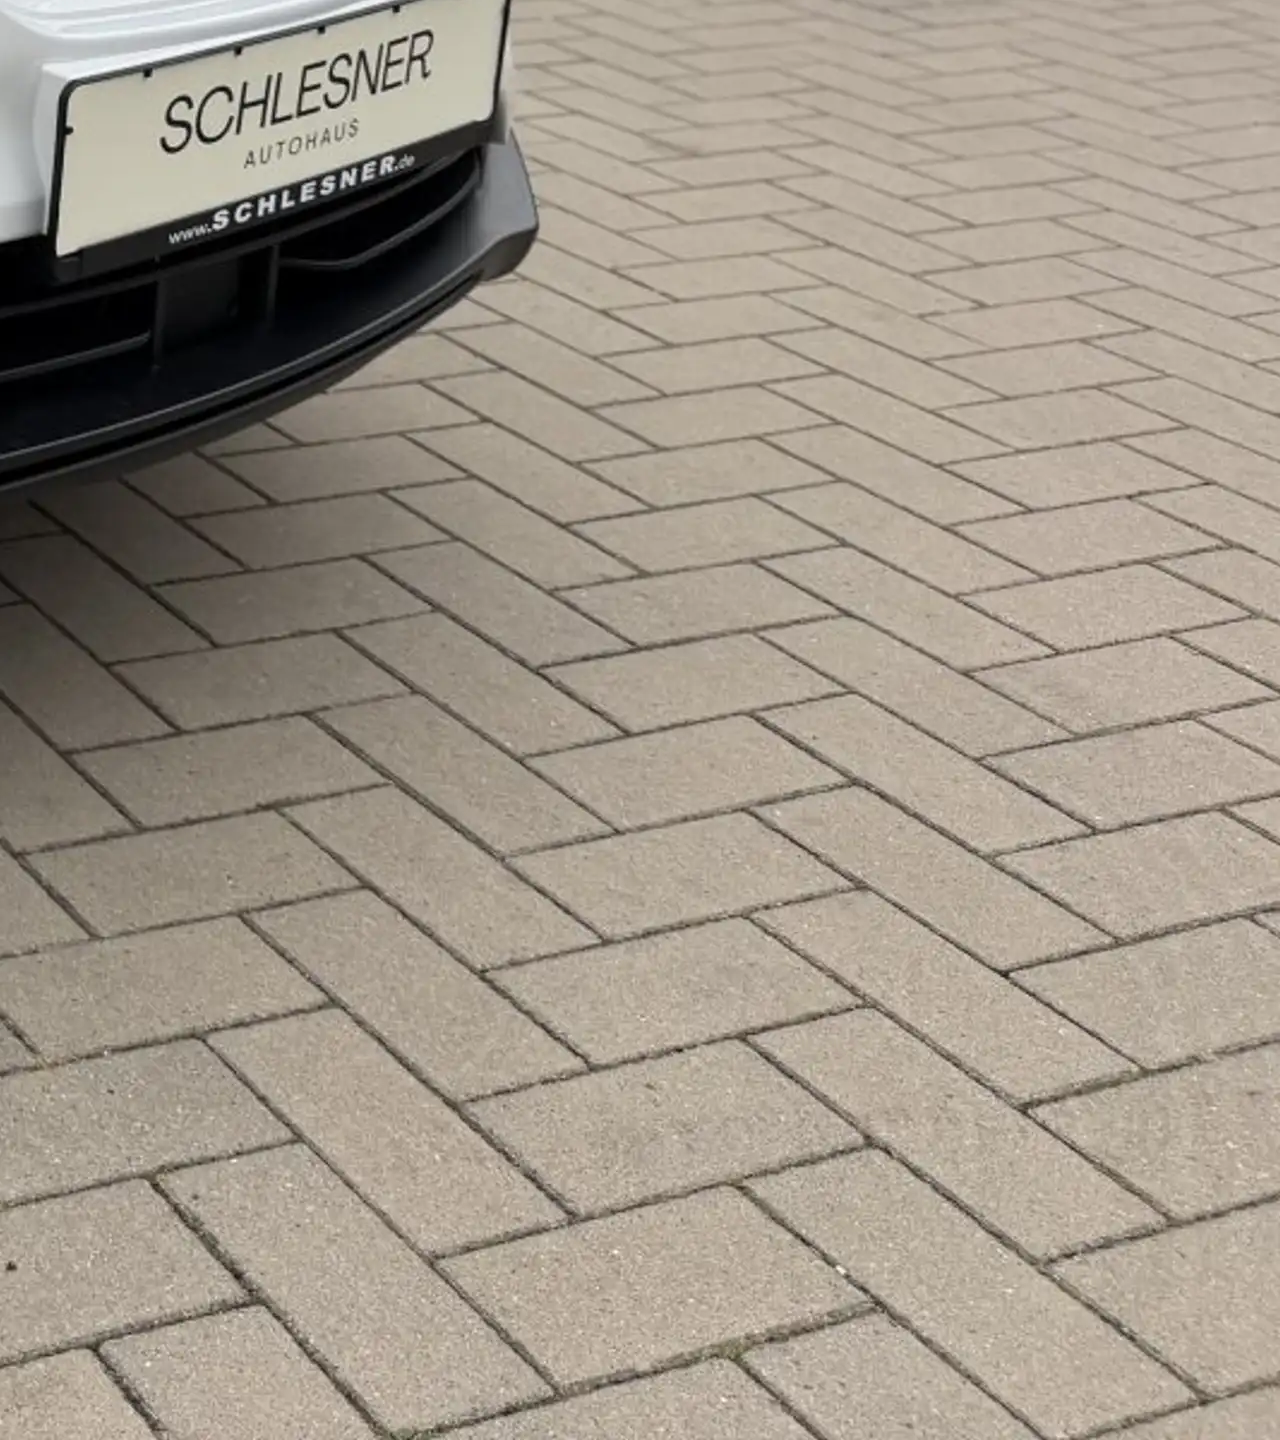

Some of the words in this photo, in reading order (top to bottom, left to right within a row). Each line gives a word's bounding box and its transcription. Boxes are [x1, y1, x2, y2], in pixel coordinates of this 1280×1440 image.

[159, 28, 434, 154] SCHLESNER
[243, 118, 359, 169] AUTOHAUS
[168, 155, 415, 244] www.SCHLESNER.de
